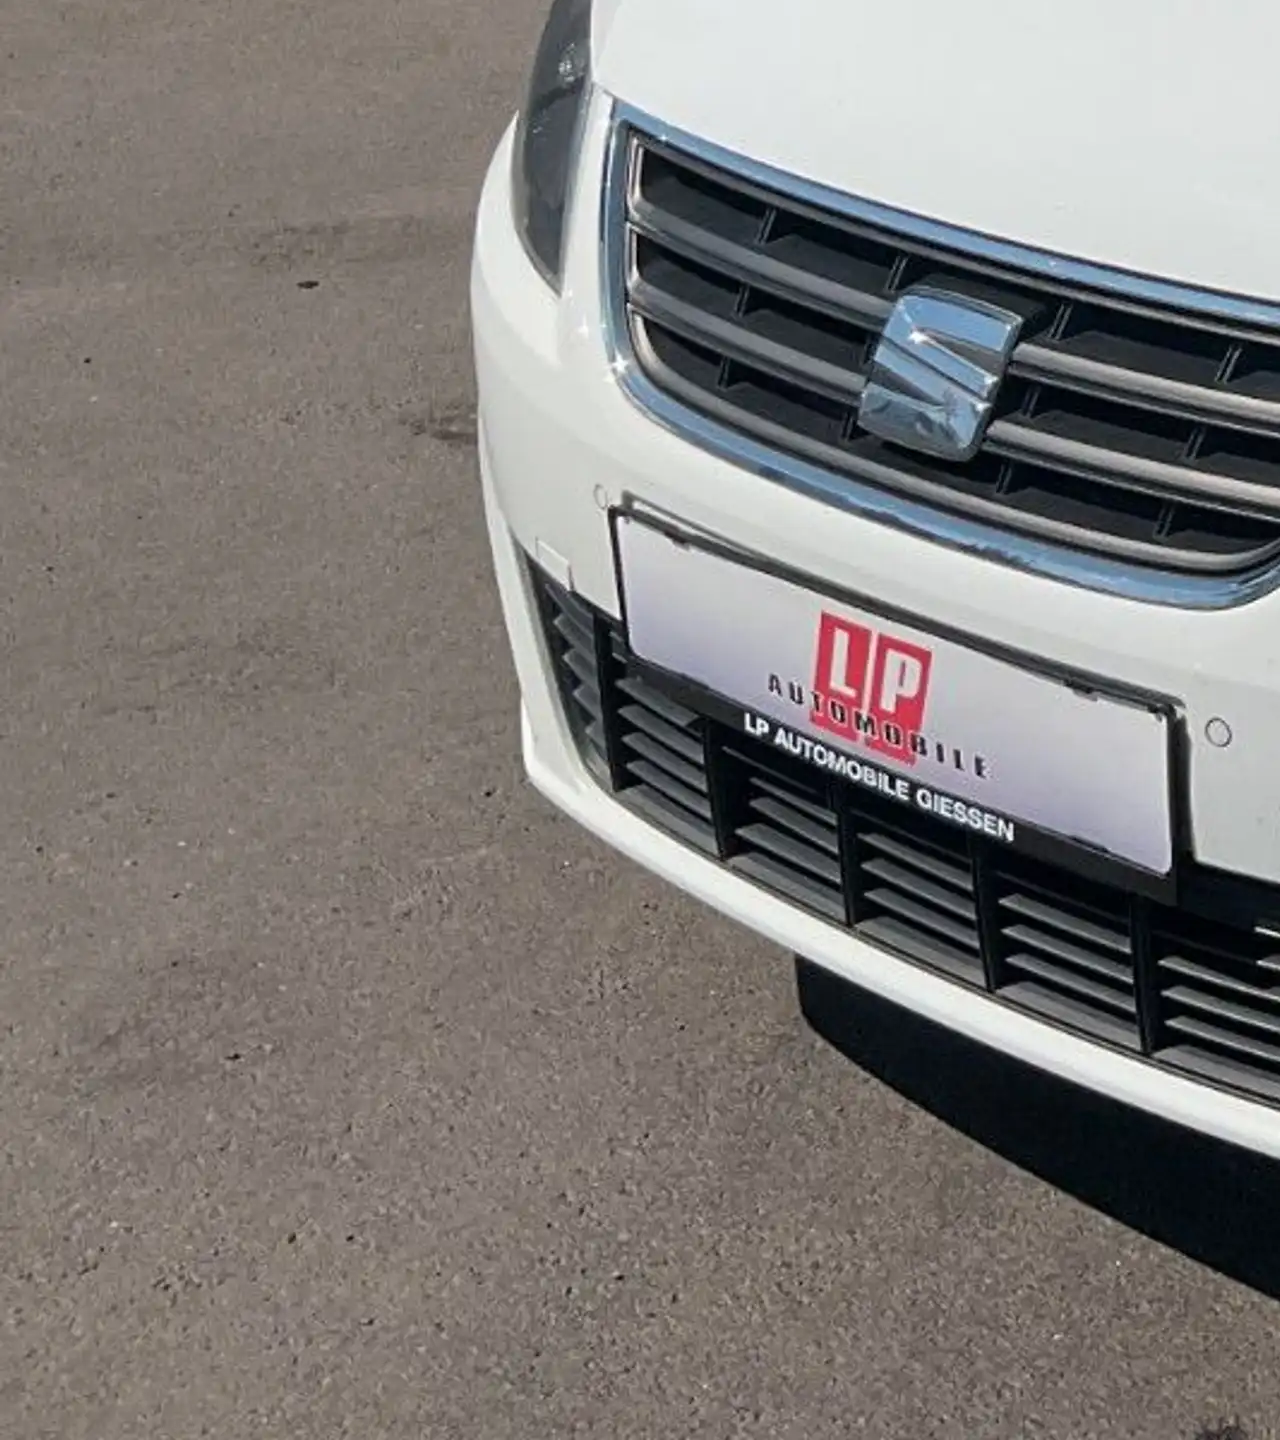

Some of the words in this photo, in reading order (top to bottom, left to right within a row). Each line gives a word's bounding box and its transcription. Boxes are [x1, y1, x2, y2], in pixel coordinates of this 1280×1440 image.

[823, 621, 928, 722] LP
[743, 712, 770, 737] LP
[773, 727, 911, 802] AUTOMOBILE
[915, 787, 1016, 843] GIESSEN
[767, 672, 992, 779] AUTOMOBILE
